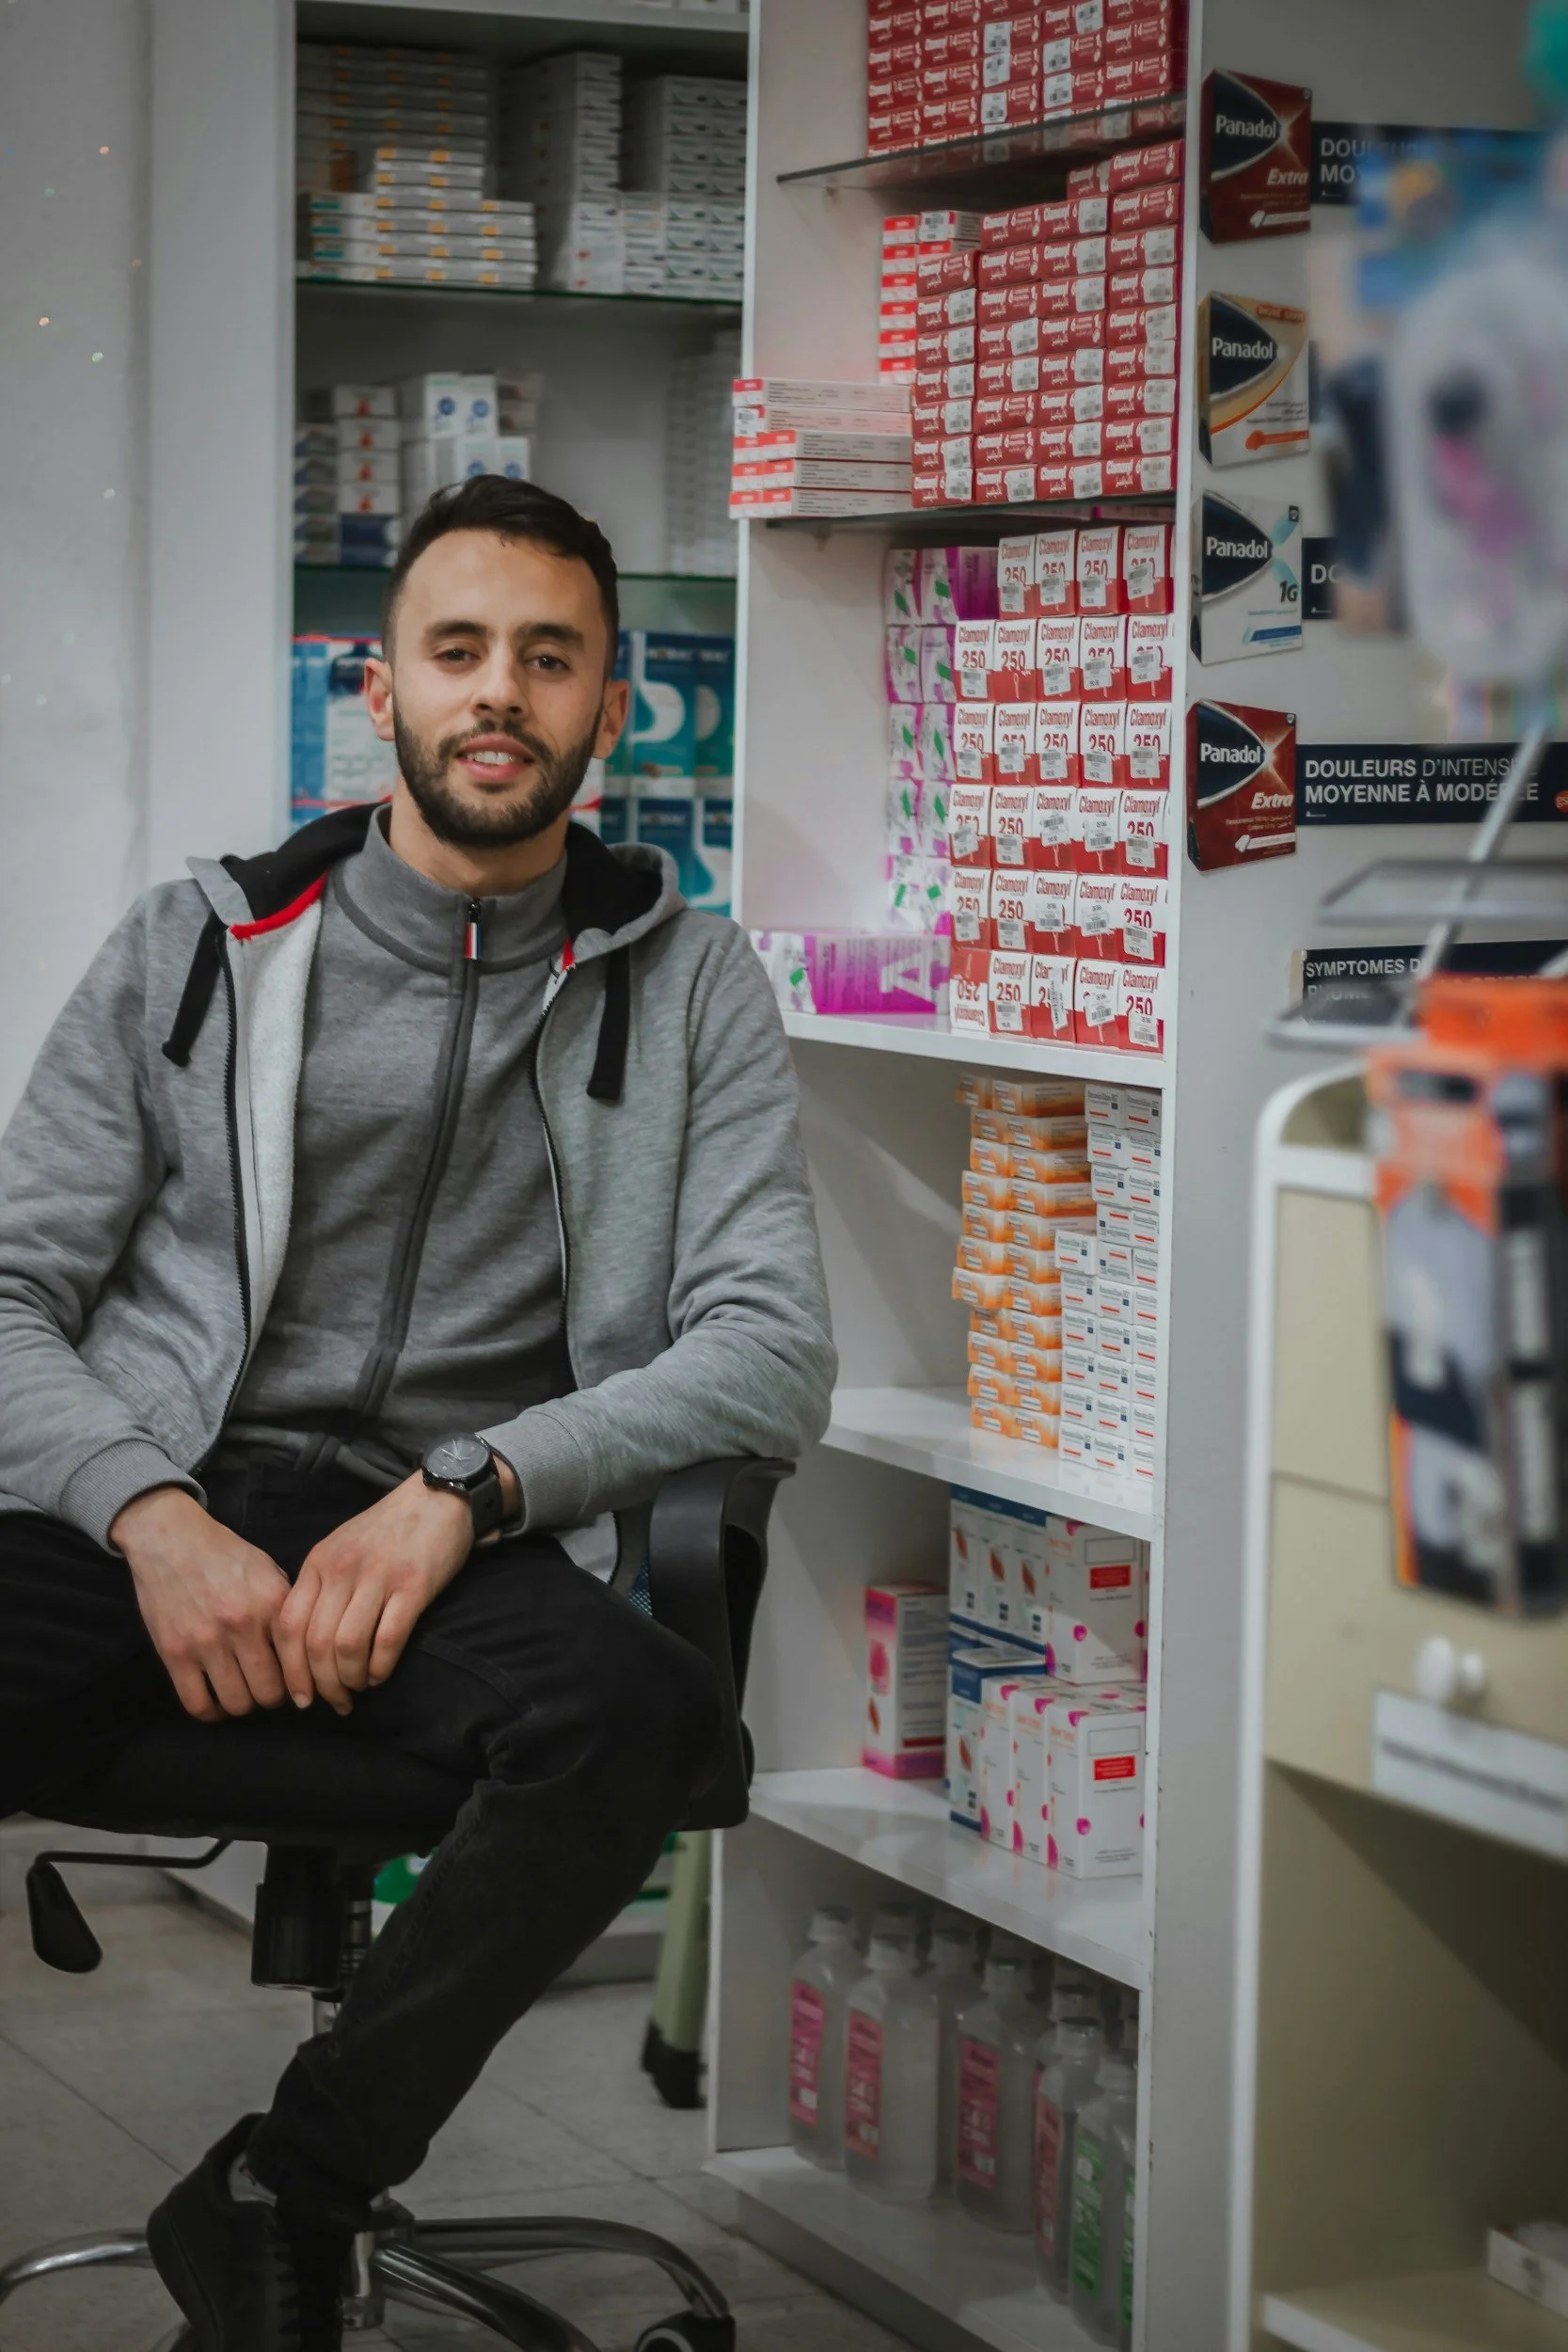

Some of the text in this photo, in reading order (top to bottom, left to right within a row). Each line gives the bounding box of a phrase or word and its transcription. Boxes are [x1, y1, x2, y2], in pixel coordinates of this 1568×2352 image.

[1215, 115, 1277, 139] Panadol
[1266, 167, 1309, 186] Extra
[1212, 336, 1274, 359] Panadol
[1206, 535, 1268, 559] Panadol
[1005, 565, 1027, 585] 250
[1085, 559, 1108, 580] 250
[1279, 580, 1299, 603] 1G
[961, 650, 986, 669] 250
[1001, 649, 1026, 672] 250
[961, 732, 985, 754] 250
[1088, 734, 1115, 755] 250
[1200, 742, 1260, 764] Panadol
[1305, 758, 1538, 778] DOULEURS D'INTENS
[1250, 791, 1294, 810] Extra
[1305, 779, 1539, 803] MOYENNE À MODÉE
[998, 816, 1023, 836] 250
[998, 898, 1023, 919] 250
[1035, 961, 1070, 985] Clayl
[1306, 958, 1405, 977] SYMPTOMES
[997, 981, 1022, 1002] 250
[1126, 994, 1153, 1016] 250
